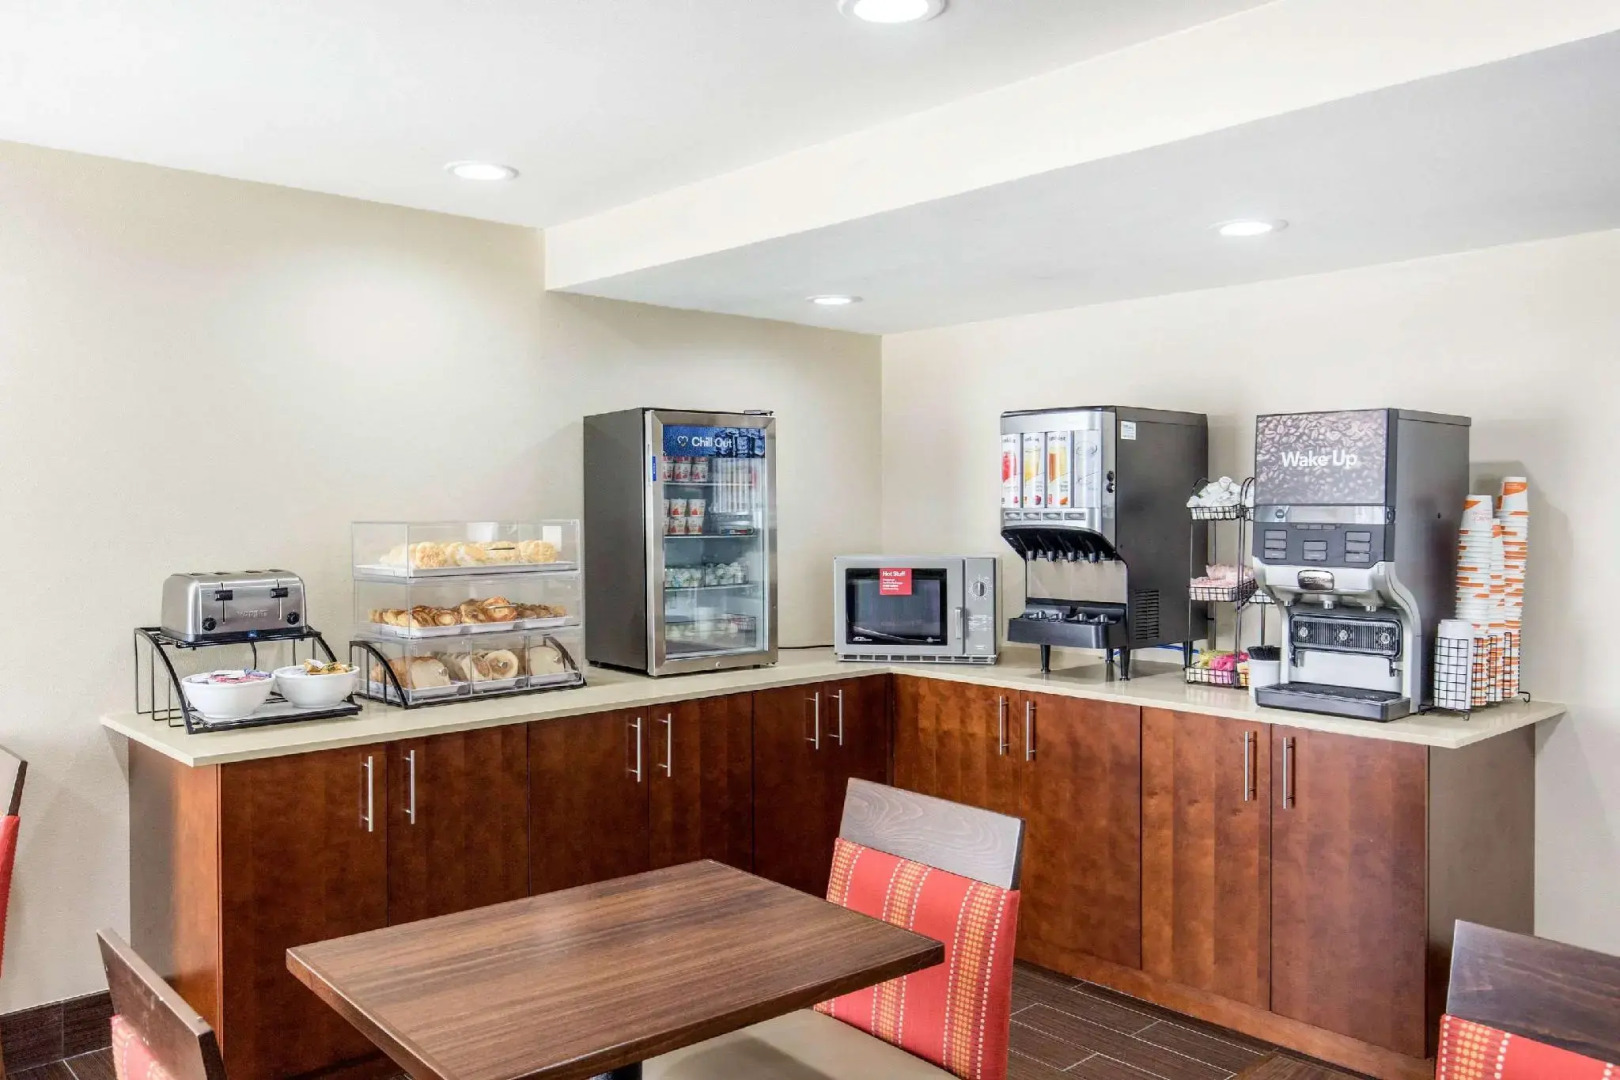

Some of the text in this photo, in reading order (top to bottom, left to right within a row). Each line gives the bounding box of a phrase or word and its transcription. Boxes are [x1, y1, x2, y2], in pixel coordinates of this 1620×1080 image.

[691, 436, 733, 448] Chill Out
[1280, 449, 1358, 469] Wake Up
